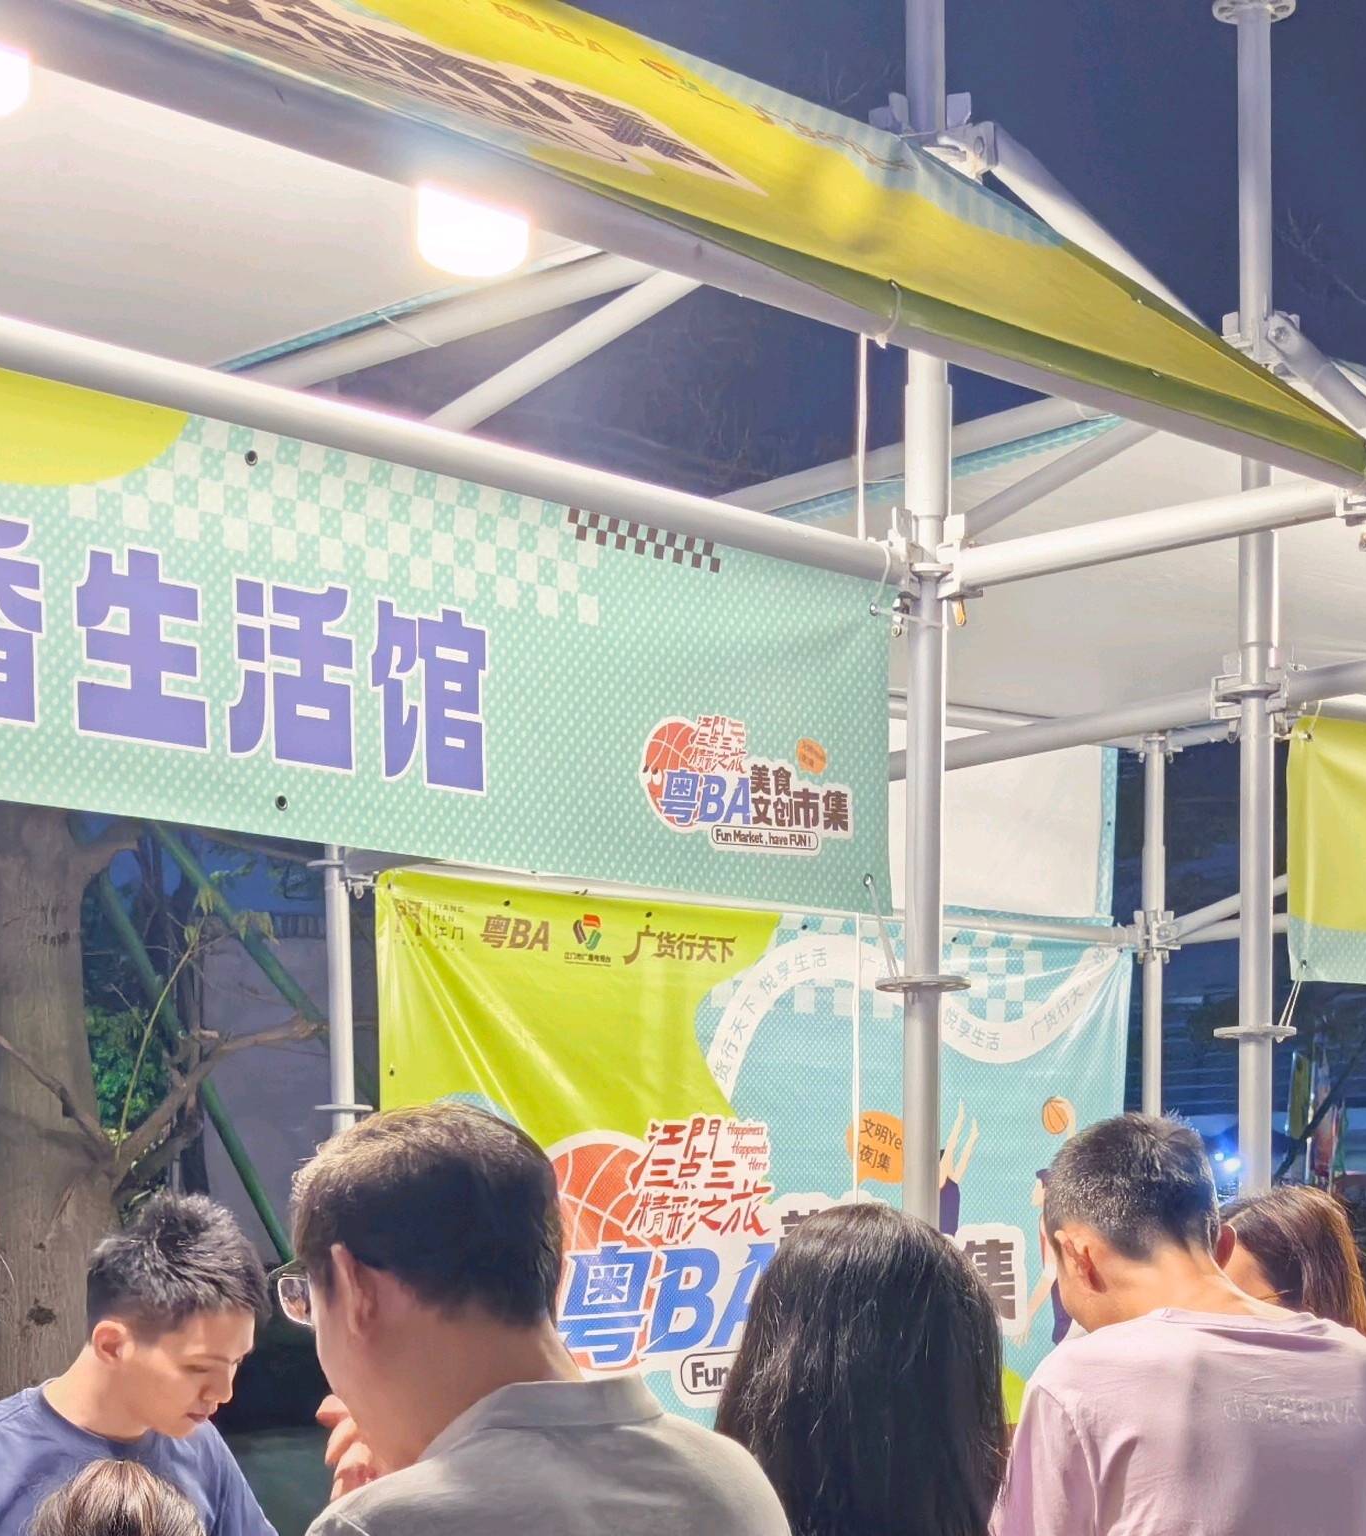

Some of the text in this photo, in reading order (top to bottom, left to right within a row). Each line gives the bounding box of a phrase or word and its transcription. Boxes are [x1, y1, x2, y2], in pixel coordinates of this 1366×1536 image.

[660, 768, 752, 825] 粤BA
[750, 764, 792, 797] 美食
[792, 788, 849, 832] 市集
[716, 830, 732, 841] Fun
[769, 832, 788, 845] have
[480, 914, 550, 952] 粤BA
[622, 924, 738, 966] 广货行天下
